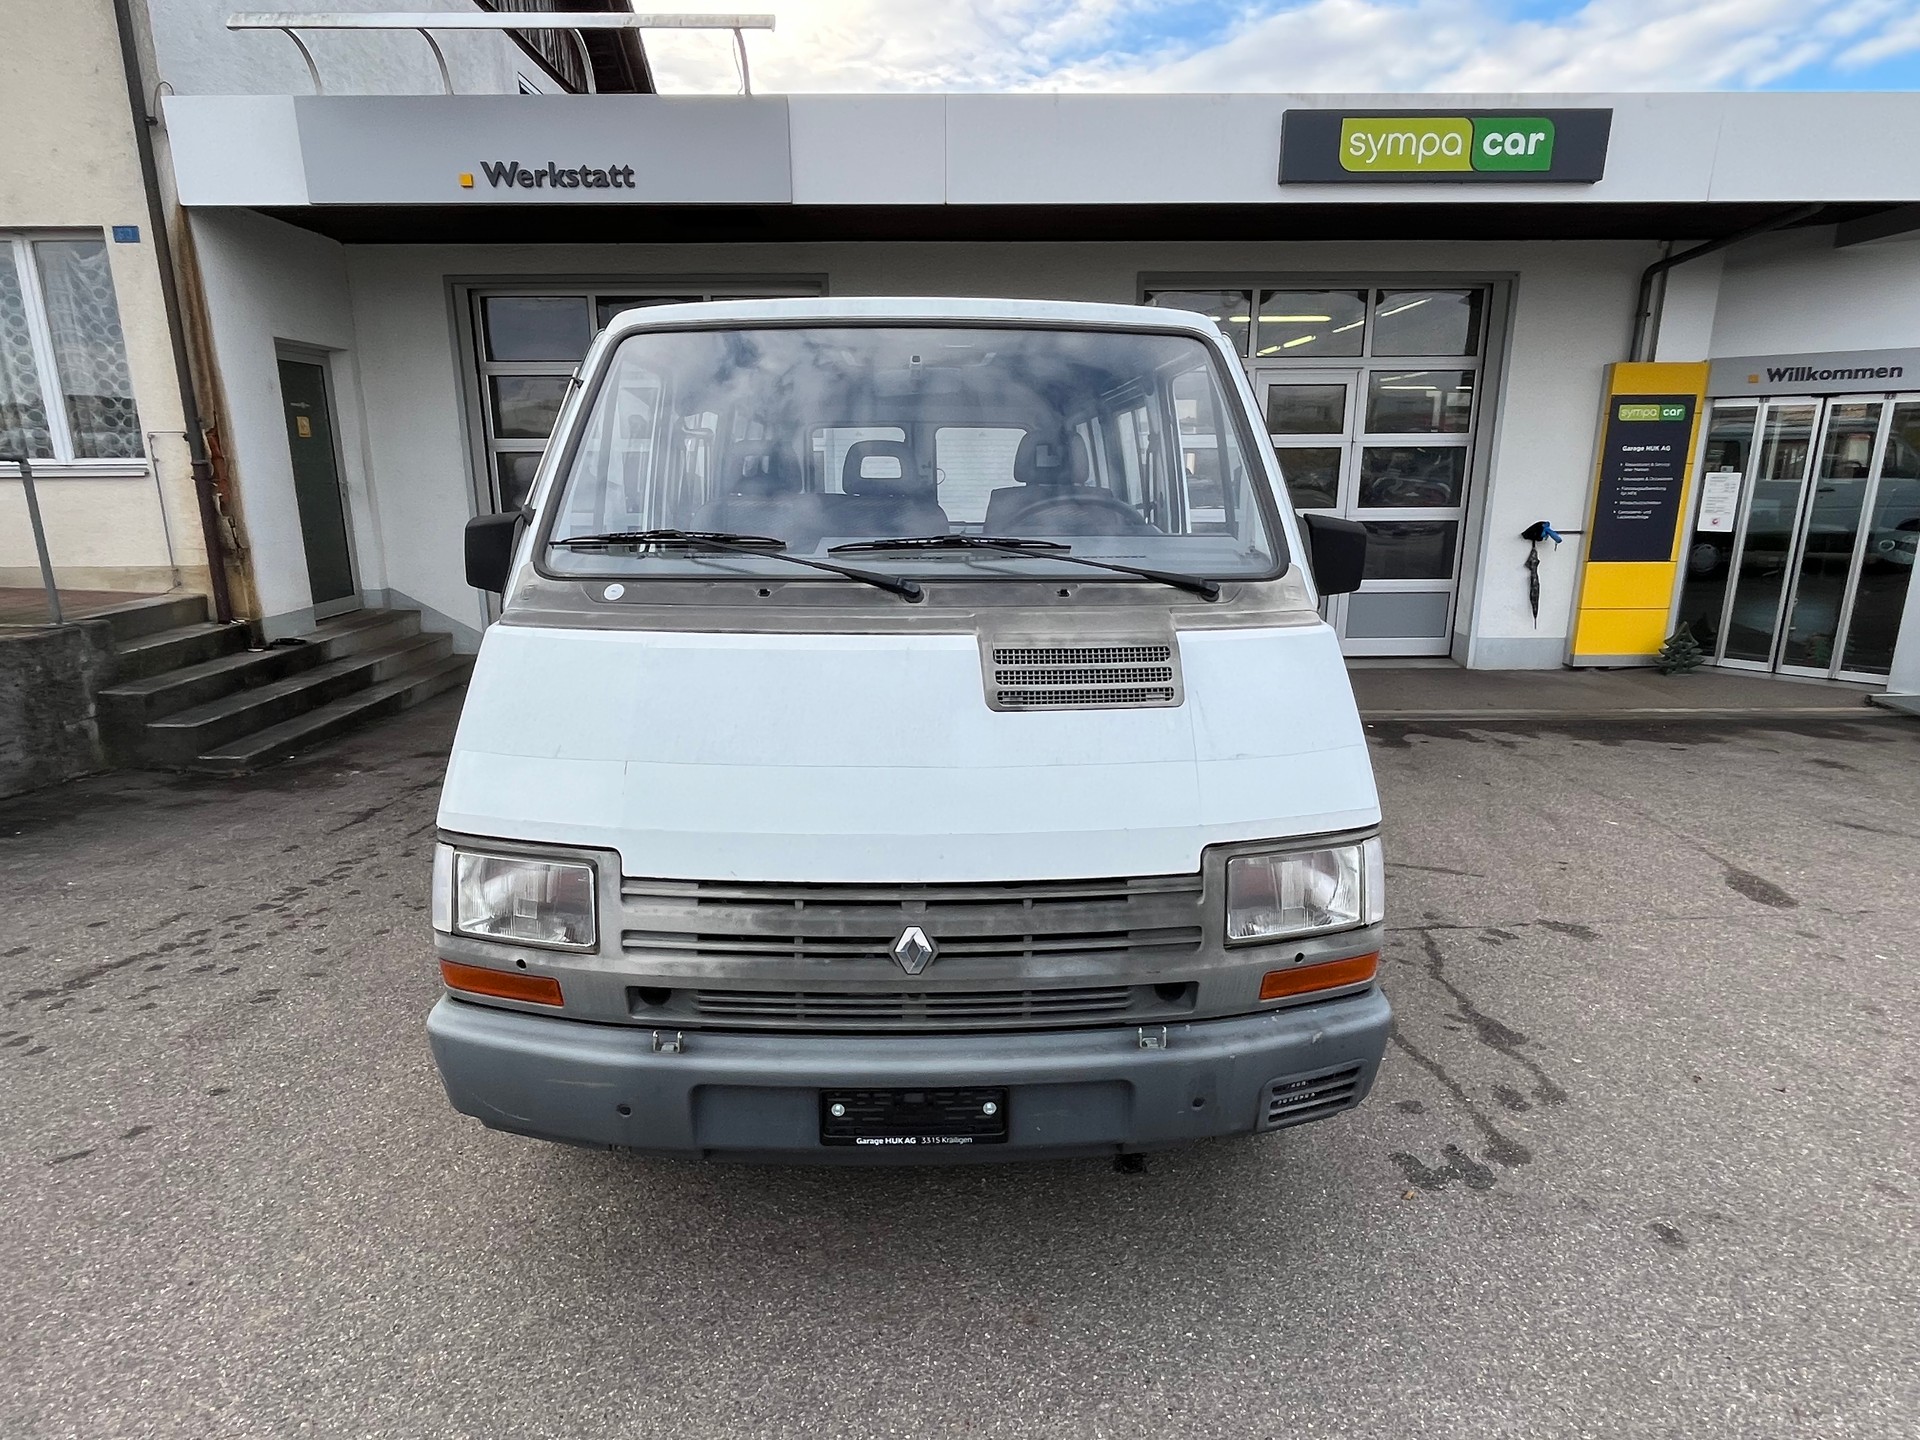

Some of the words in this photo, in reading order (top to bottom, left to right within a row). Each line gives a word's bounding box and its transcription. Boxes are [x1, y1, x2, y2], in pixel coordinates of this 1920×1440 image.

[1349, 131, 1464, 165] sympa
[1482, 130, 1545, 156] car
[480, 161, 635, 188] Werkstatt
[1766, 366, 1903, 382] Willkommen
[1621, 409, 1657, 418] sympa
[1663, 408, 1682, 416] car
[856, 1137, 884, 1146] Garage
[885, 1137, 904, 1145] HUK
[904, 1137, 916, 1145] AG
[921, 1136, 941, 1145] 3315
